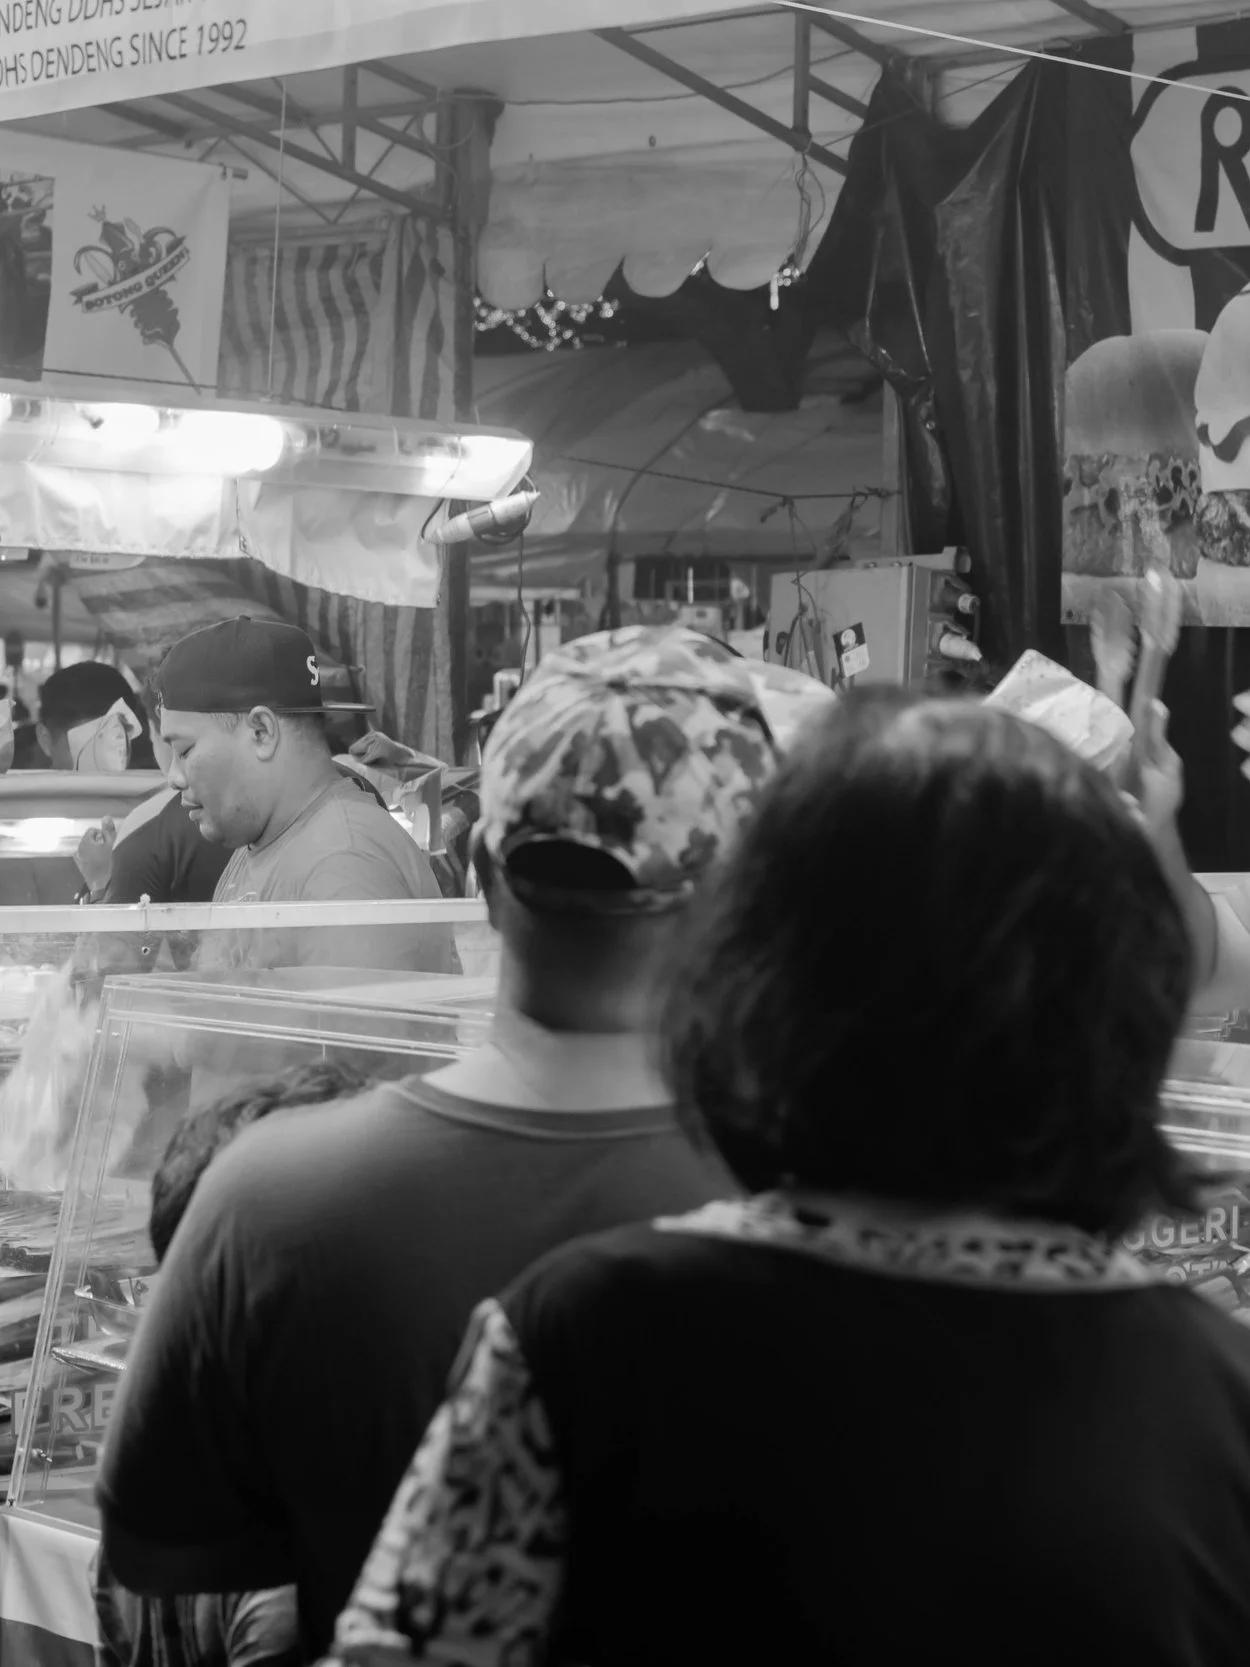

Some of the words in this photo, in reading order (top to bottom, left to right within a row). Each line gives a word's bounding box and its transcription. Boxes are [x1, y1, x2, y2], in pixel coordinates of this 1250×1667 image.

[0, 52, 27, 87] HS
[31, 36, 123, 81] DENDENG
[129, 26, 188, 66] SINCE
[197, 18, 248, 56] 1992
